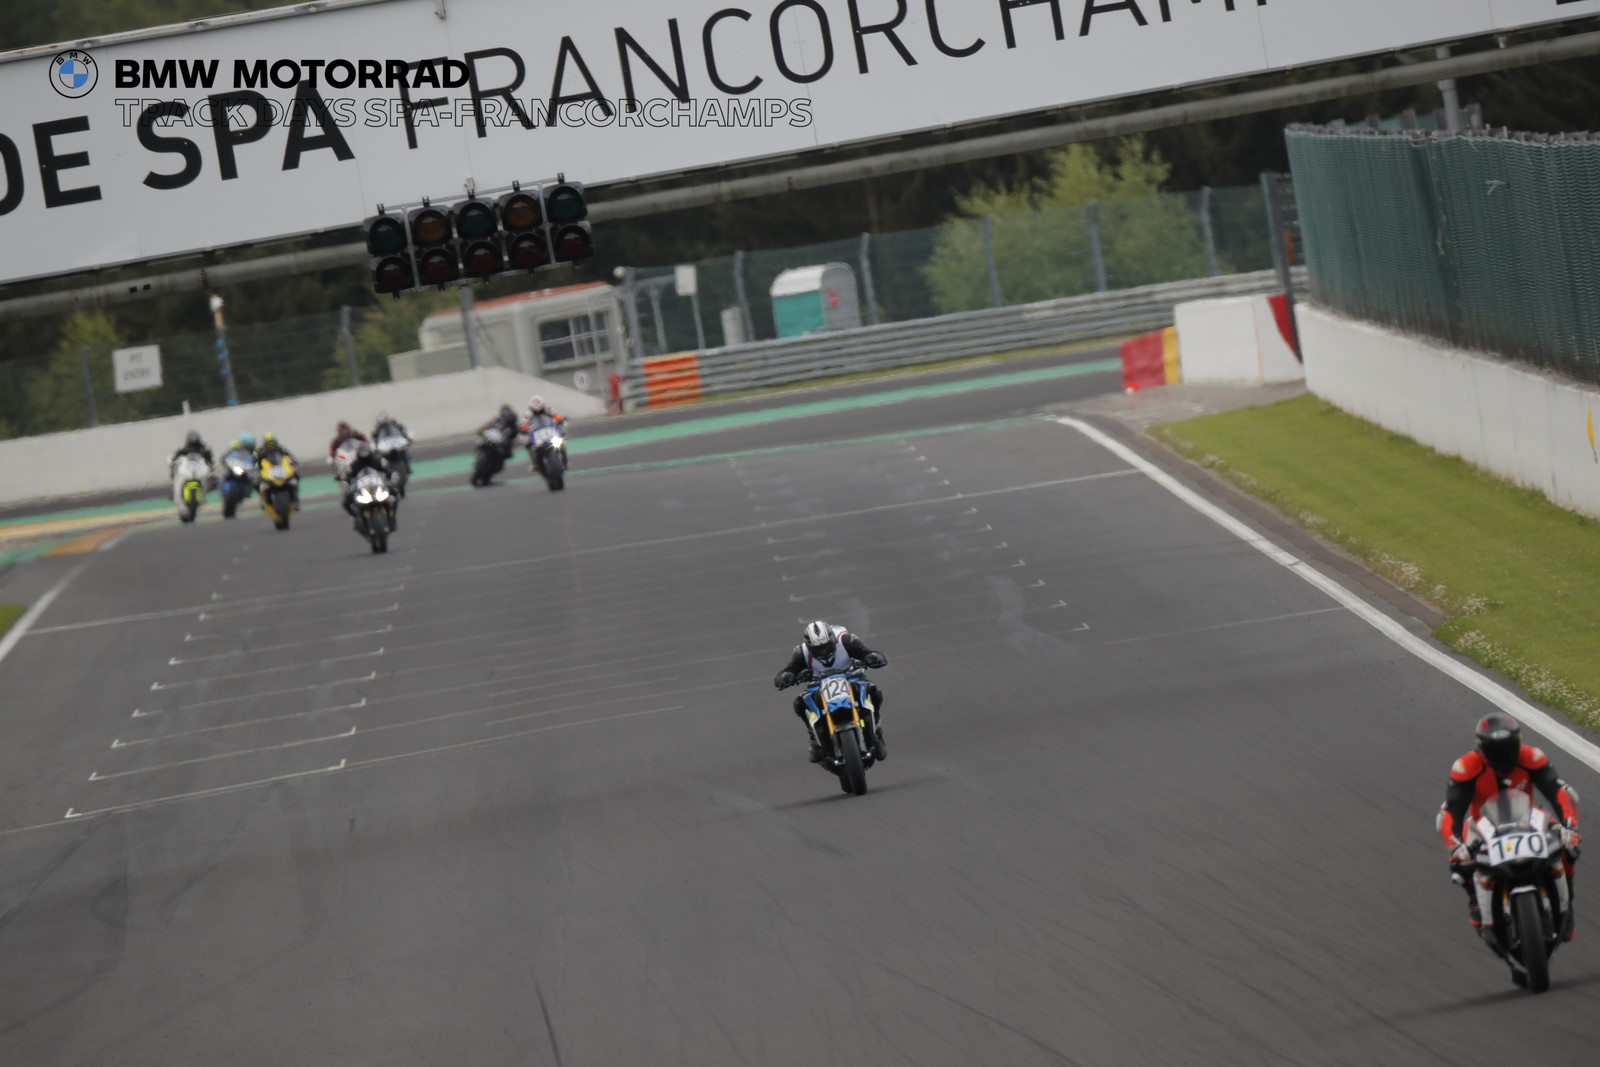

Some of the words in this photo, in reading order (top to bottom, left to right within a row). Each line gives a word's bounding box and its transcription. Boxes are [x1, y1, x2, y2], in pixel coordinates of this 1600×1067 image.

[137, 79, 355, 190] SPA
[822, 680, 850, 700] 124
[1492, 834, 1544, 860] 170
